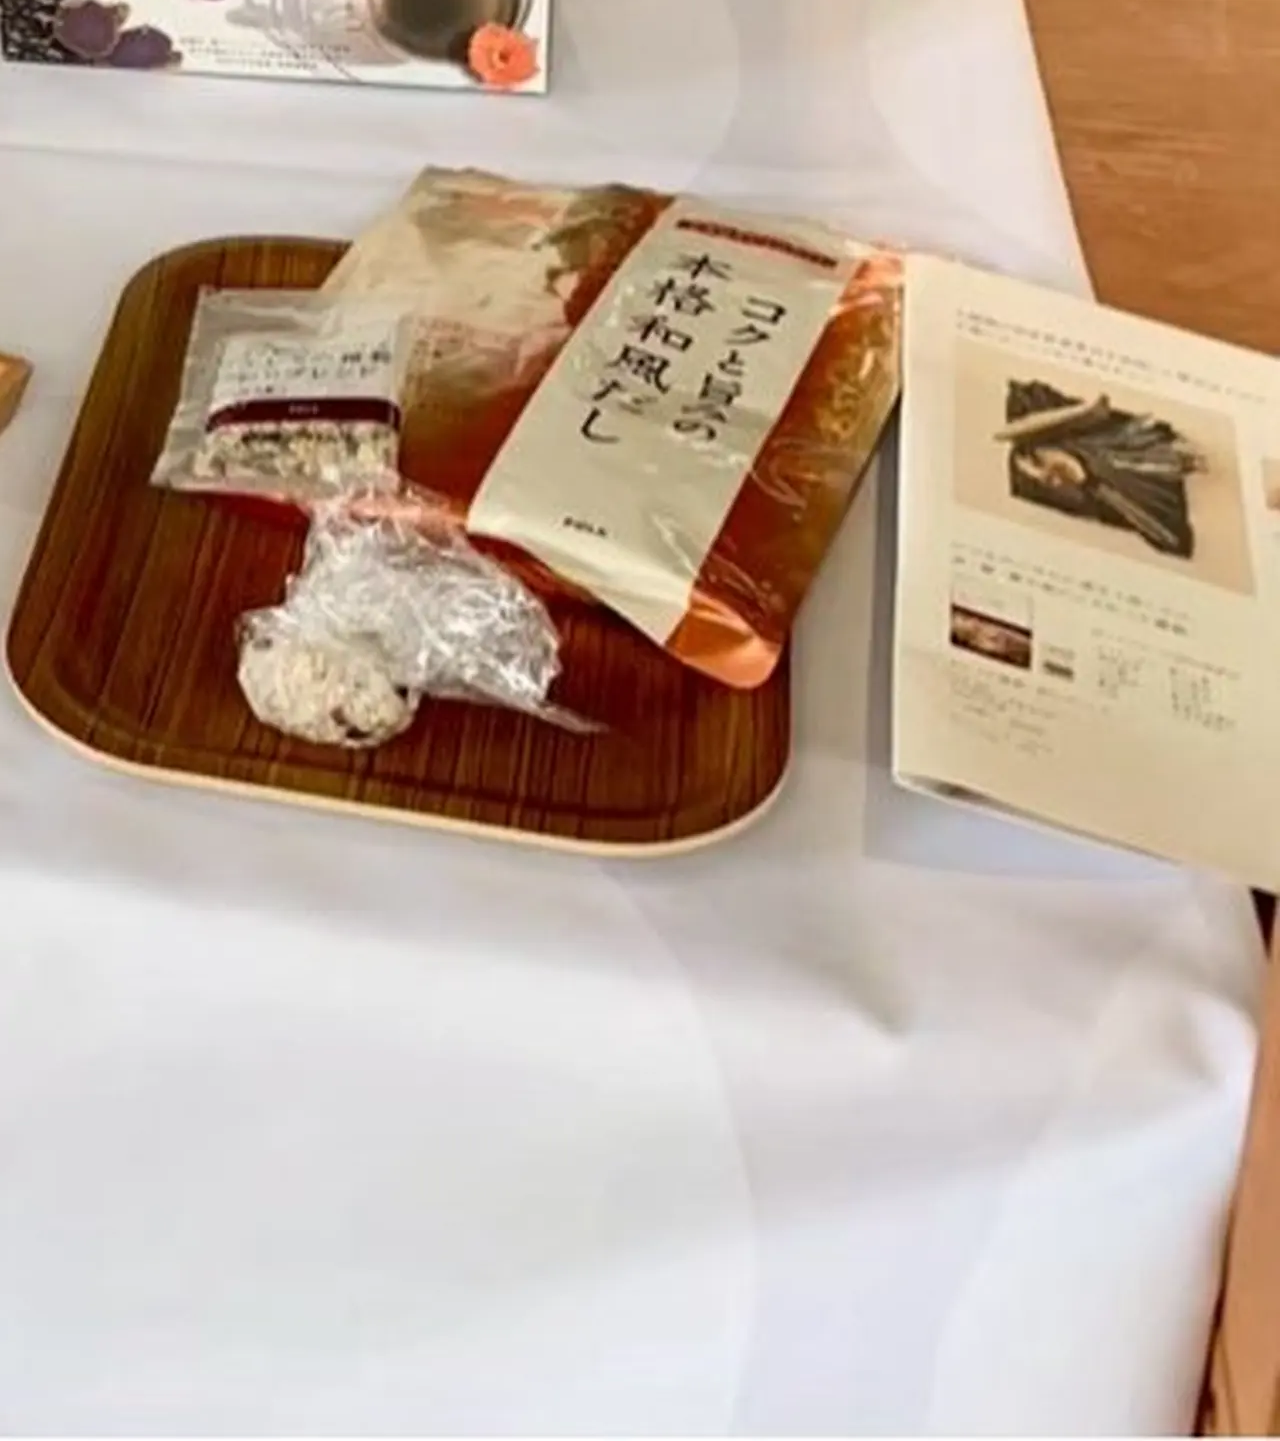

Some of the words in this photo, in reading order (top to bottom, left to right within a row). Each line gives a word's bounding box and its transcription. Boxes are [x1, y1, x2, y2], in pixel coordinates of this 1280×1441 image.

[579, 253, 733, 443] 本格和風だし
